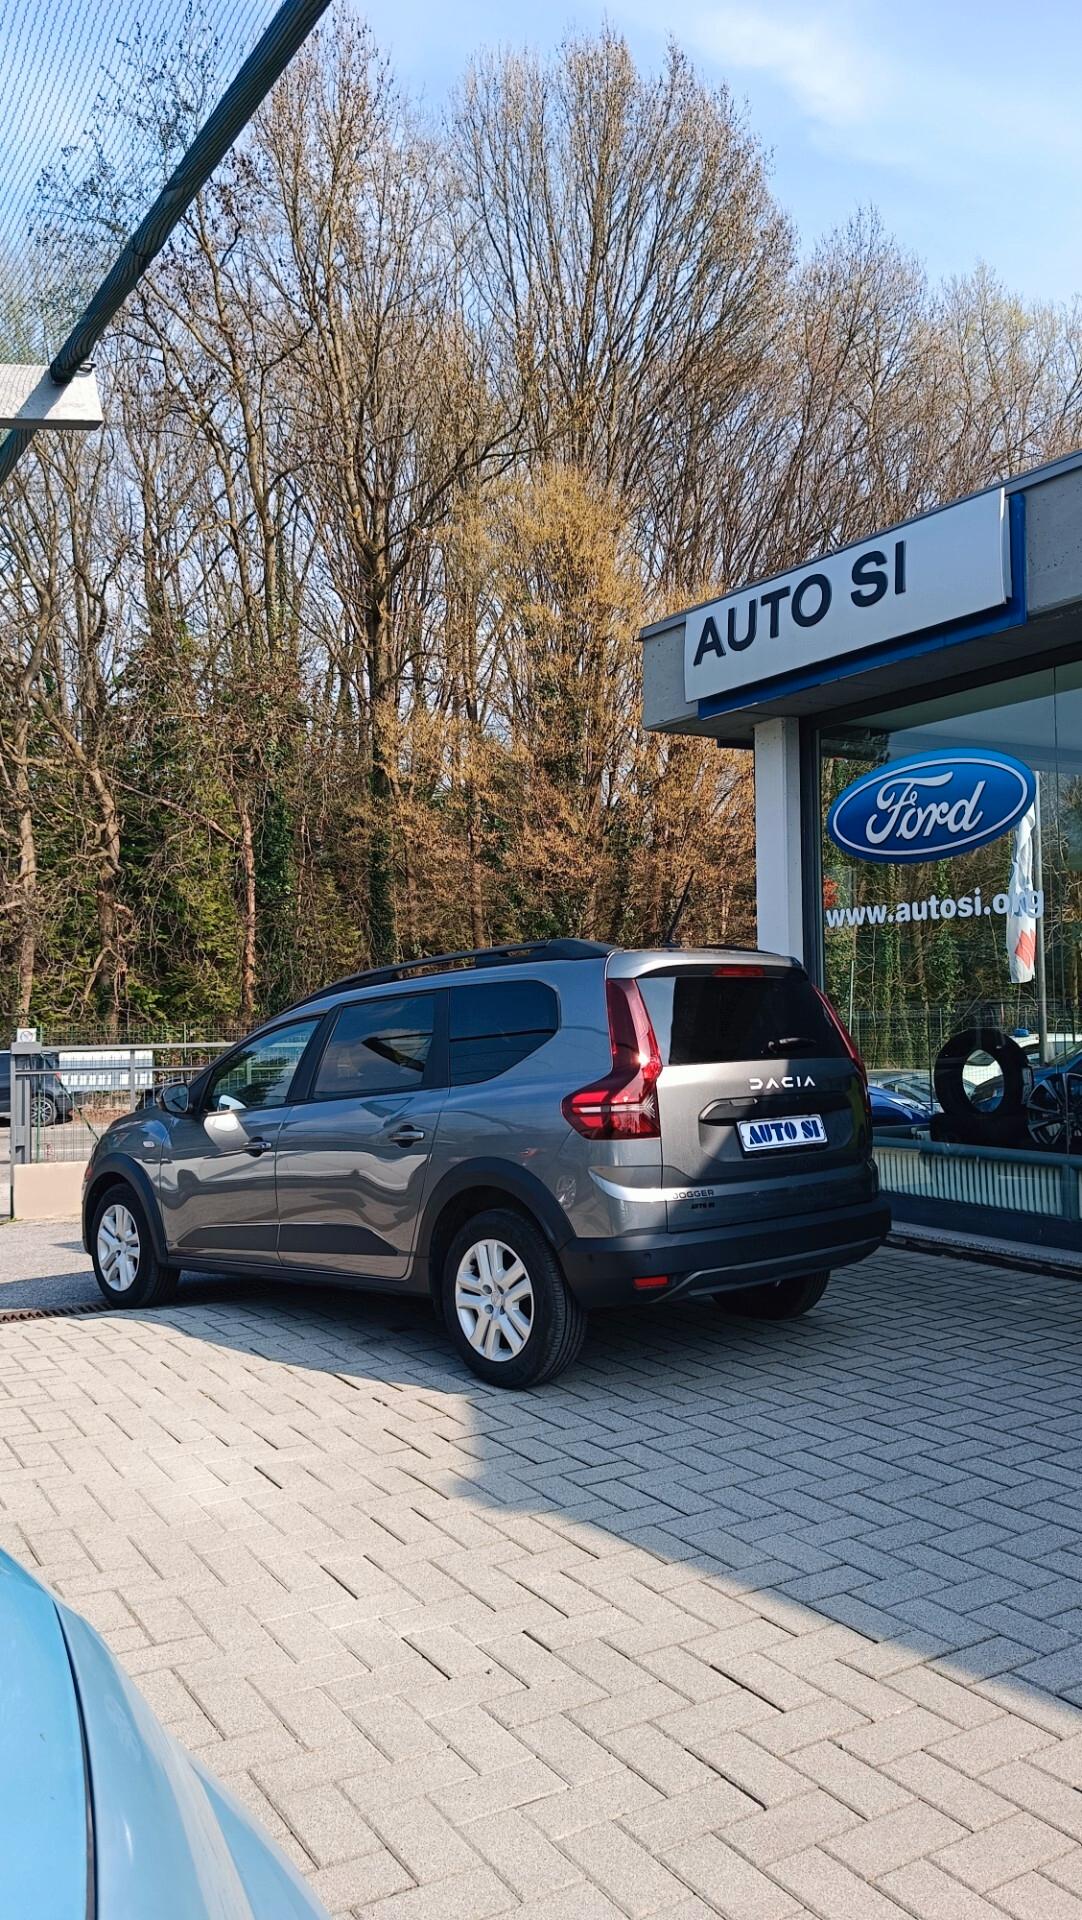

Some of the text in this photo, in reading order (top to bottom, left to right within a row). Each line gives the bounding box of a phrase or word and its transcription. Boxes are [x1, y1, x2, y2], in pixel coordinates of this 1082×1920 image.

[693, 540, 906, 666] AUTO SI
[865, 771, 986, 844] Ford
[826, 888, 1045, 928] www.autosi.org
[749, 1075, 816, 1090] DACIA
[749, 1119, 821, 1145] AUTO SI
[673, 1189, 715, 1199] JOGGER
